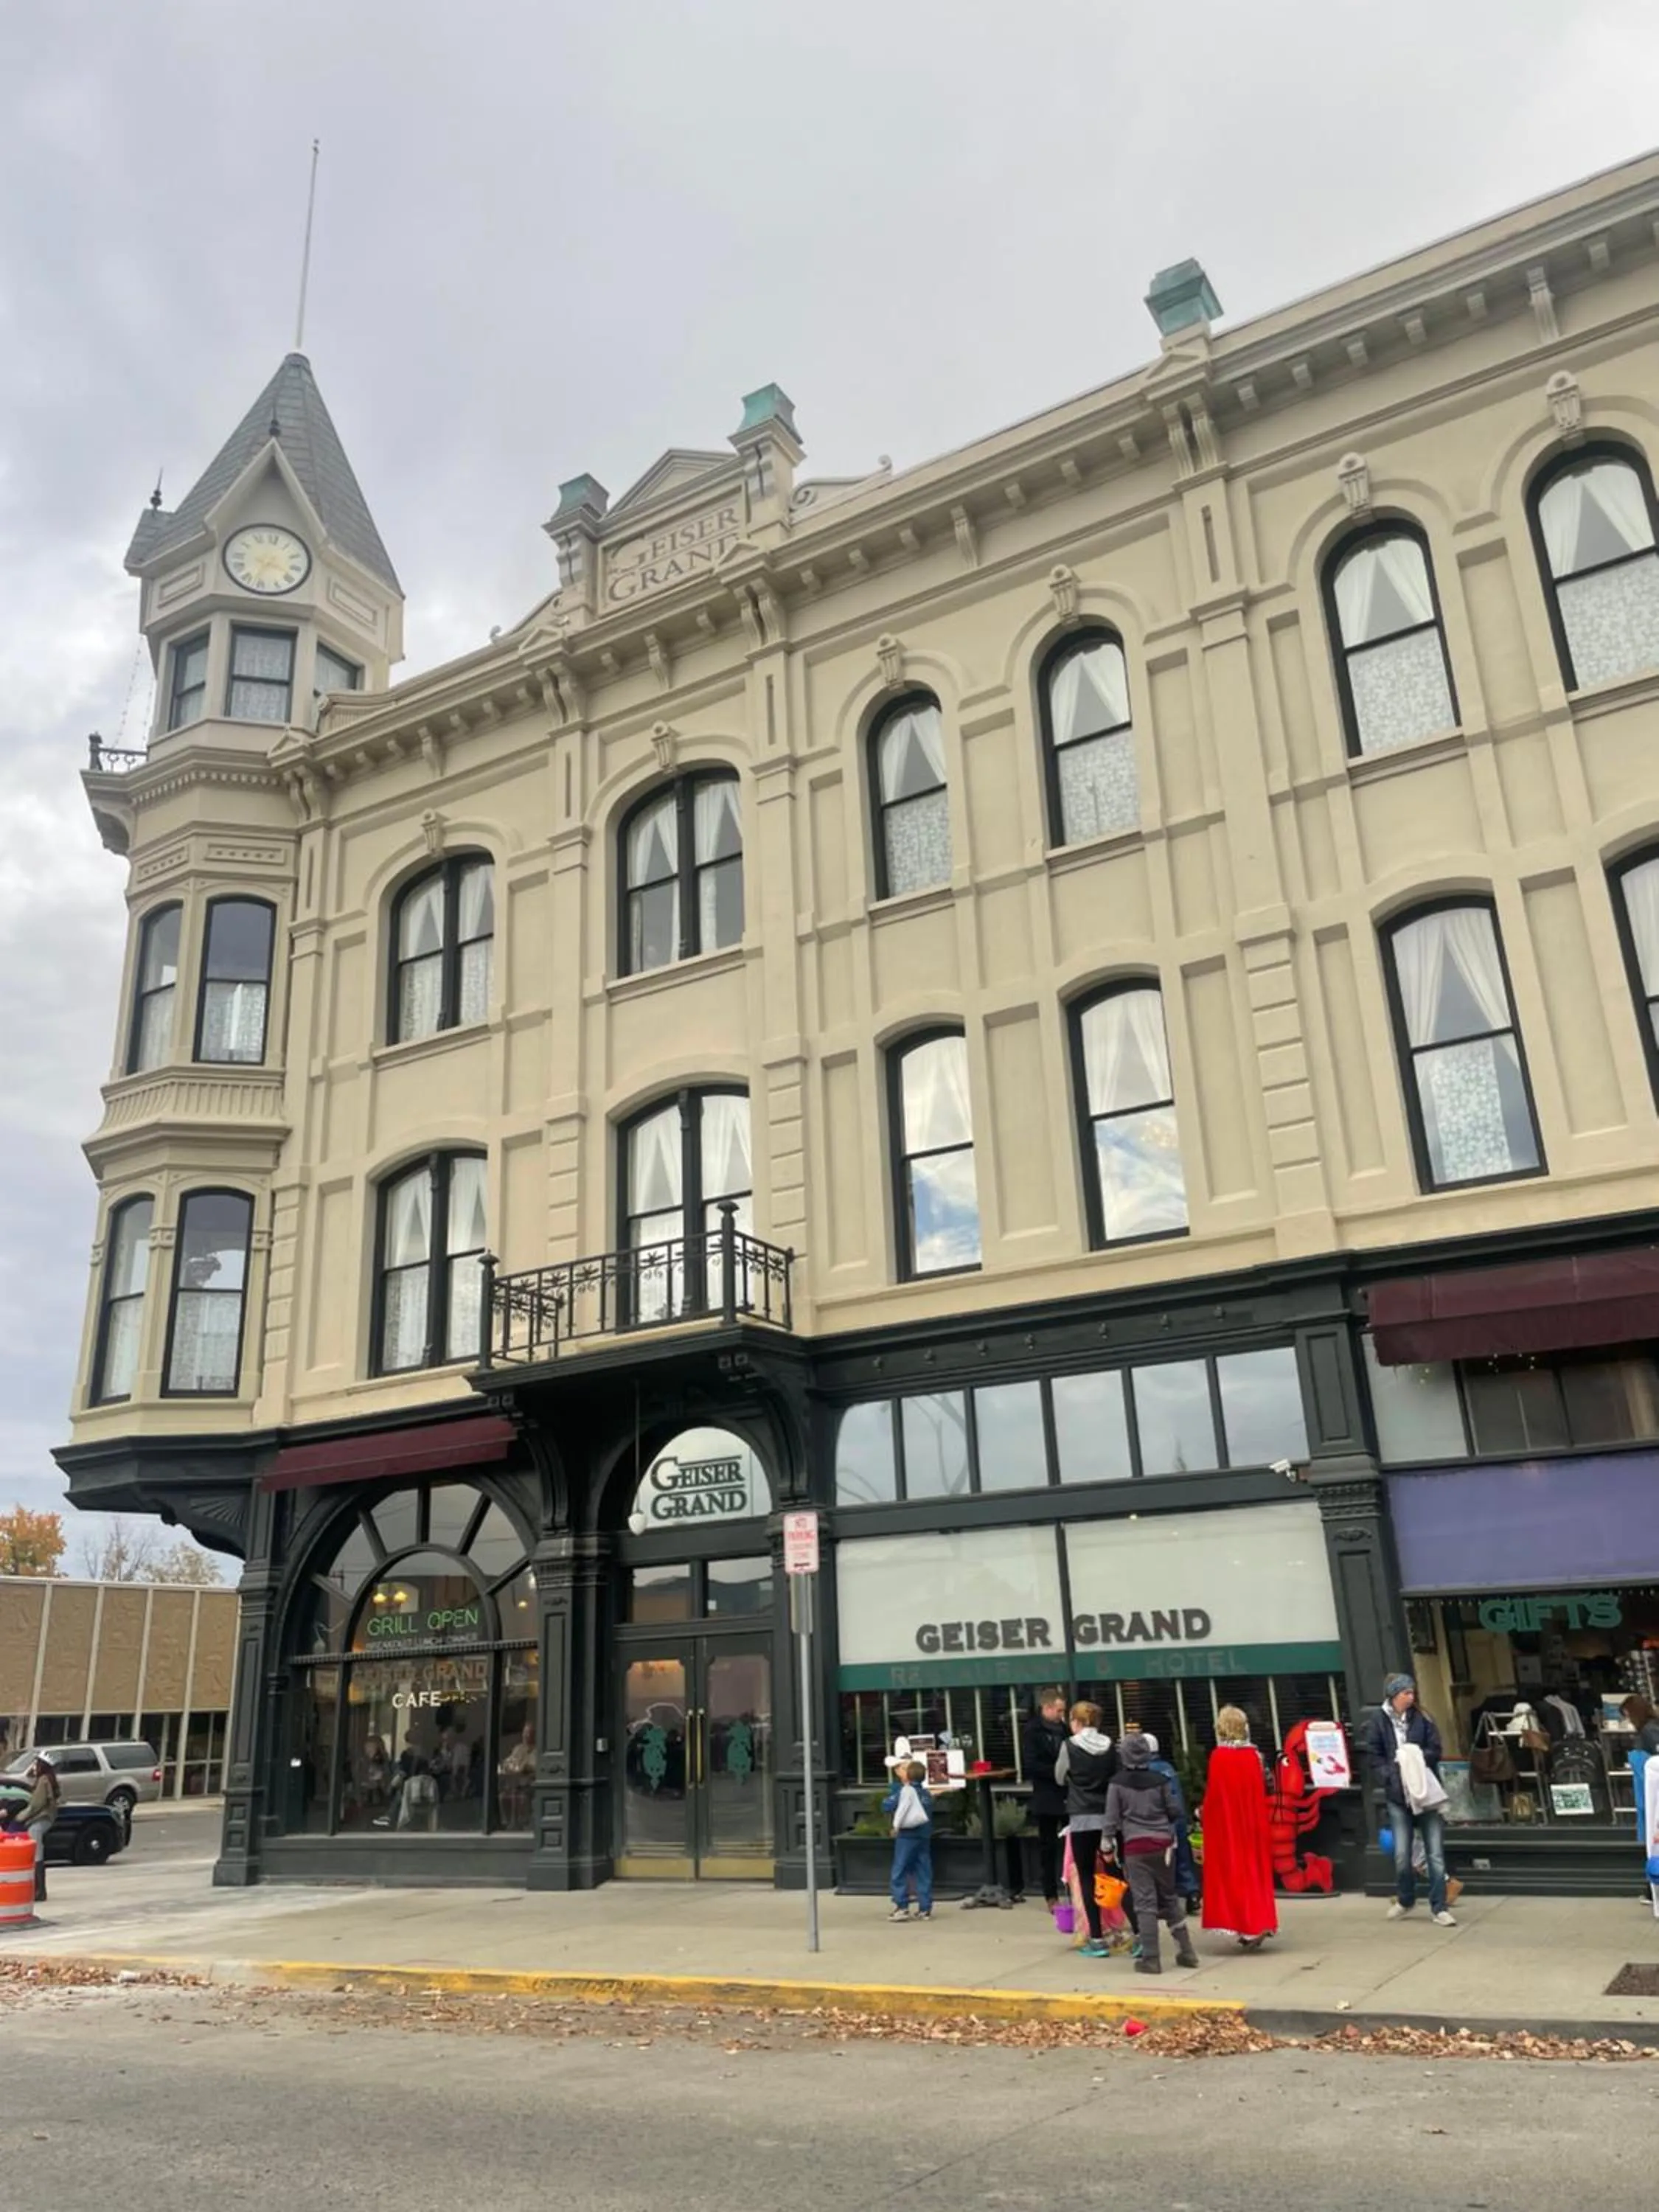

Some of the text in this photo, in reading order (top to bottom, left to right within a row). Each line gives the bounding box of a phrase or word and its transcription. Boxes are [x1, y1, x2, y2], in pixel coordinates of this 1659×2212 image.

[652, 1492, 747, 1520] GRAND
[367, 1609, 479, 1636] GRILL OPEN
[1479, 1595, 1623, 1633] GIFTS
[916, 1608, 1211, 1653] GEISER GRAND
[423, 1660, 488, 1682] GRAND
[392, 1691, 442, 1708] CAFE
